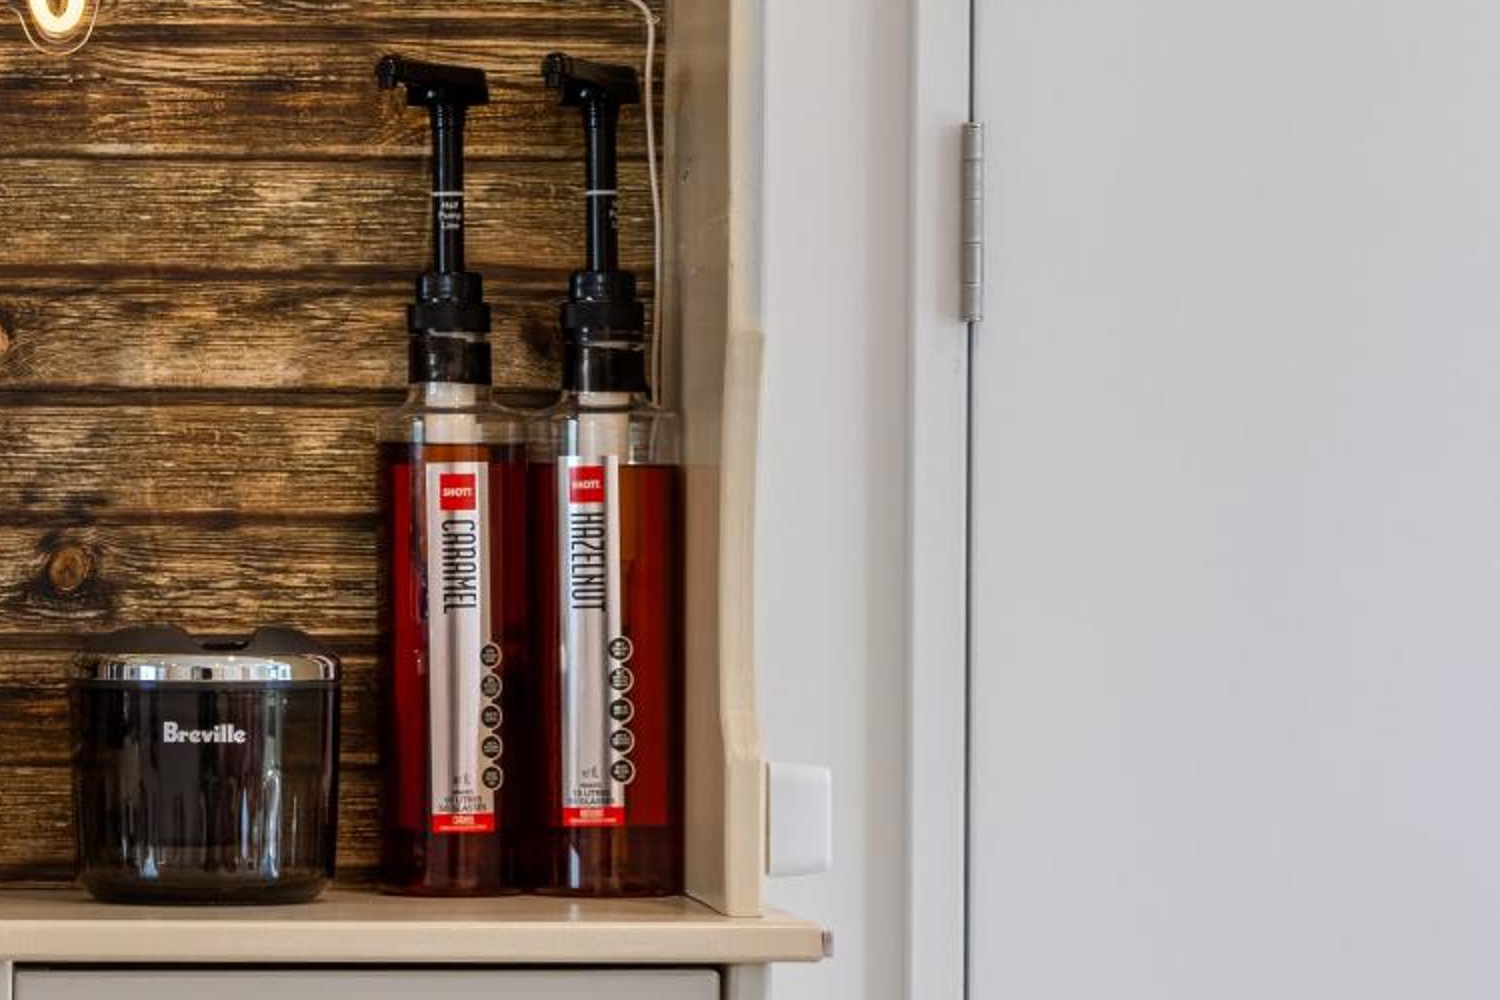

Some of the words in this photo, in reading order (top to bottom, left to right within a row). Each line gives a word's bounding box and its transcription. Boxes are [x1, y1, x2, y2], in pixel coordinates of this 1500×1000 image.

[441, 519, 477, 613] CARAMEL
[571, 512, 606, 612] HAZELNUT
[163, 721, 246, 743] Breville
